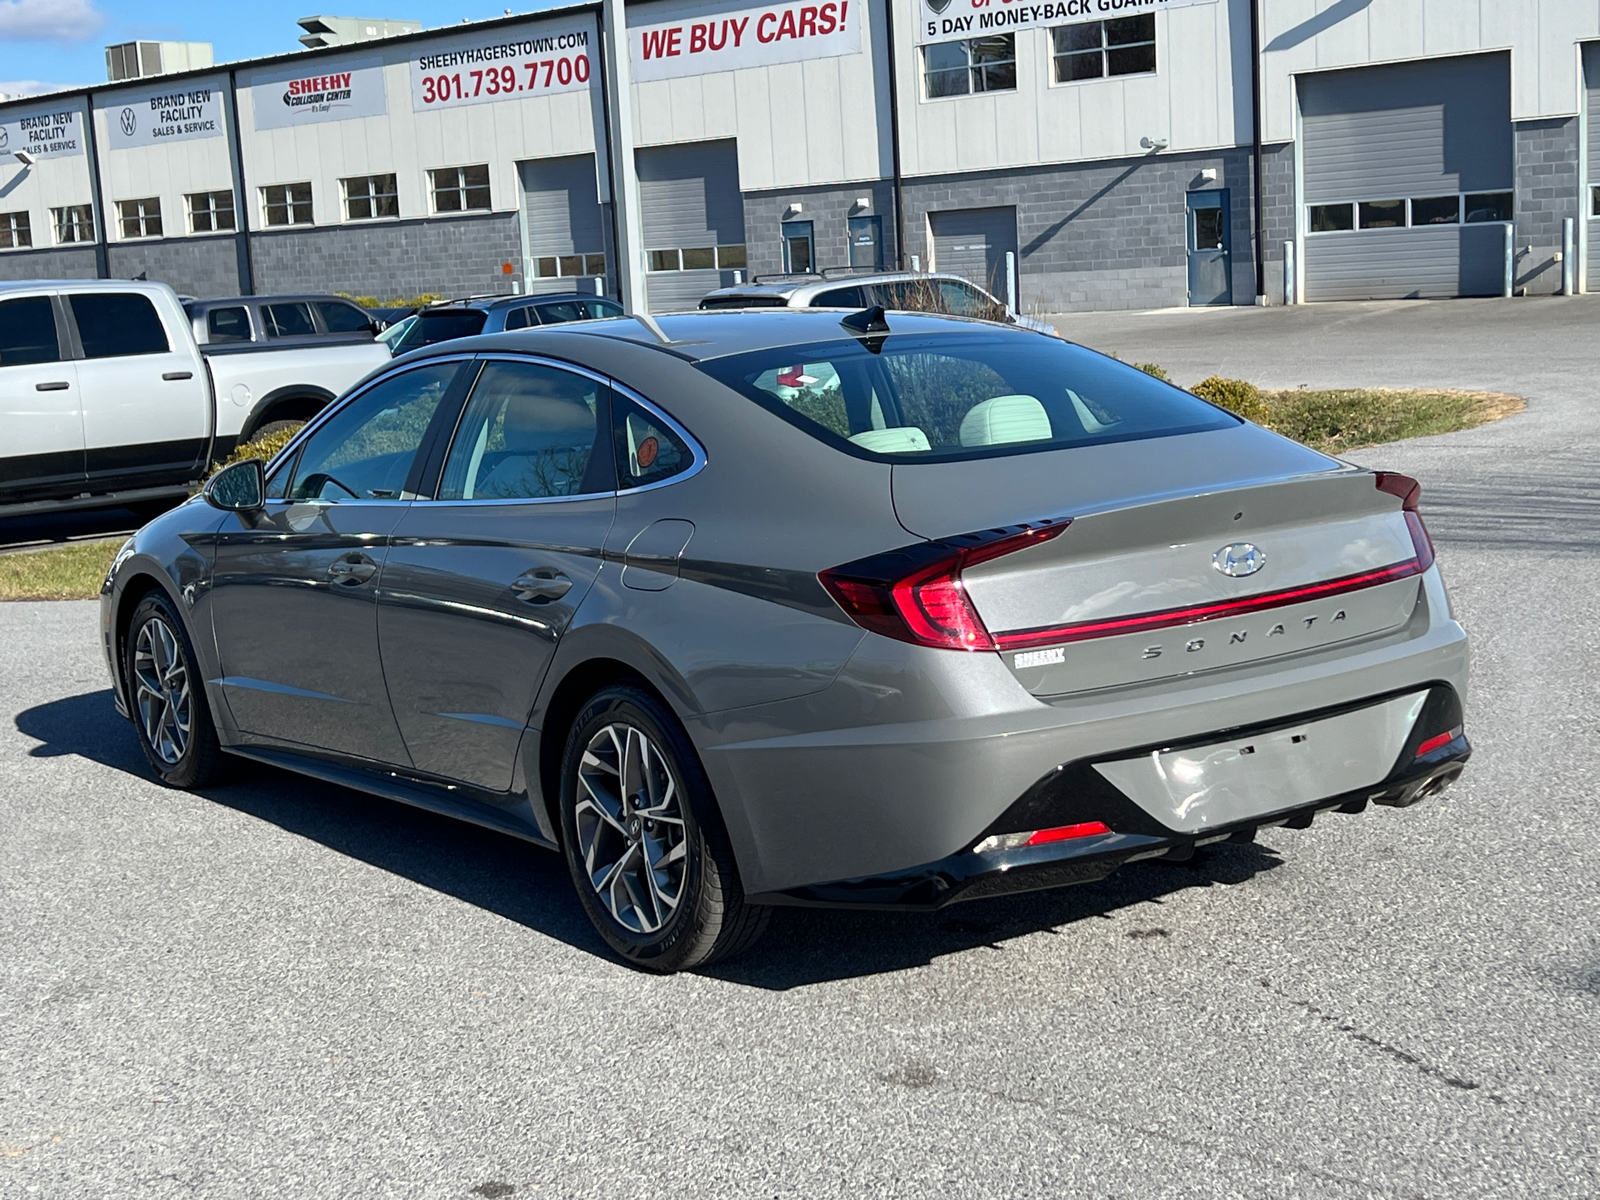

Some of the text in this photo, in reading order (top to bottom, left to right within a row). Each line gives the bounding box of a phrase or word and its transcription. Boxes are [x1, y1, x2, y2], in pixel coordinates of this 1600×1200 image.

[928, 22, 936, 36] 5
[942, 15, 974, 34] DAY
[980, 0, 1091, 29] MONEY-BACK
[642, 1, 848, 60] WE BUY CARS!
[419, 31, 588, 70] SHEEHYHAGERSTOWN.COM
[289, 72, 351, 95] SHEEHY
[422, 54, 590, 103] 301.739.7700
[150, 89, 211, 110] BRAND NEW
[291, 89, 351, 106] COLLISION CENTER
[20, 111, 73, 131] BRAND NEW
[160, 105, 203, 123] FACILITY
[28, 126, 66, 142] FACILITY
[152, 120, 215, 138] SALES & SERVICE
[43, 143, 49, 153] &
[50, 139, 77, 152] SERVICE
[1141, 609, 1347, 660] SONATA
